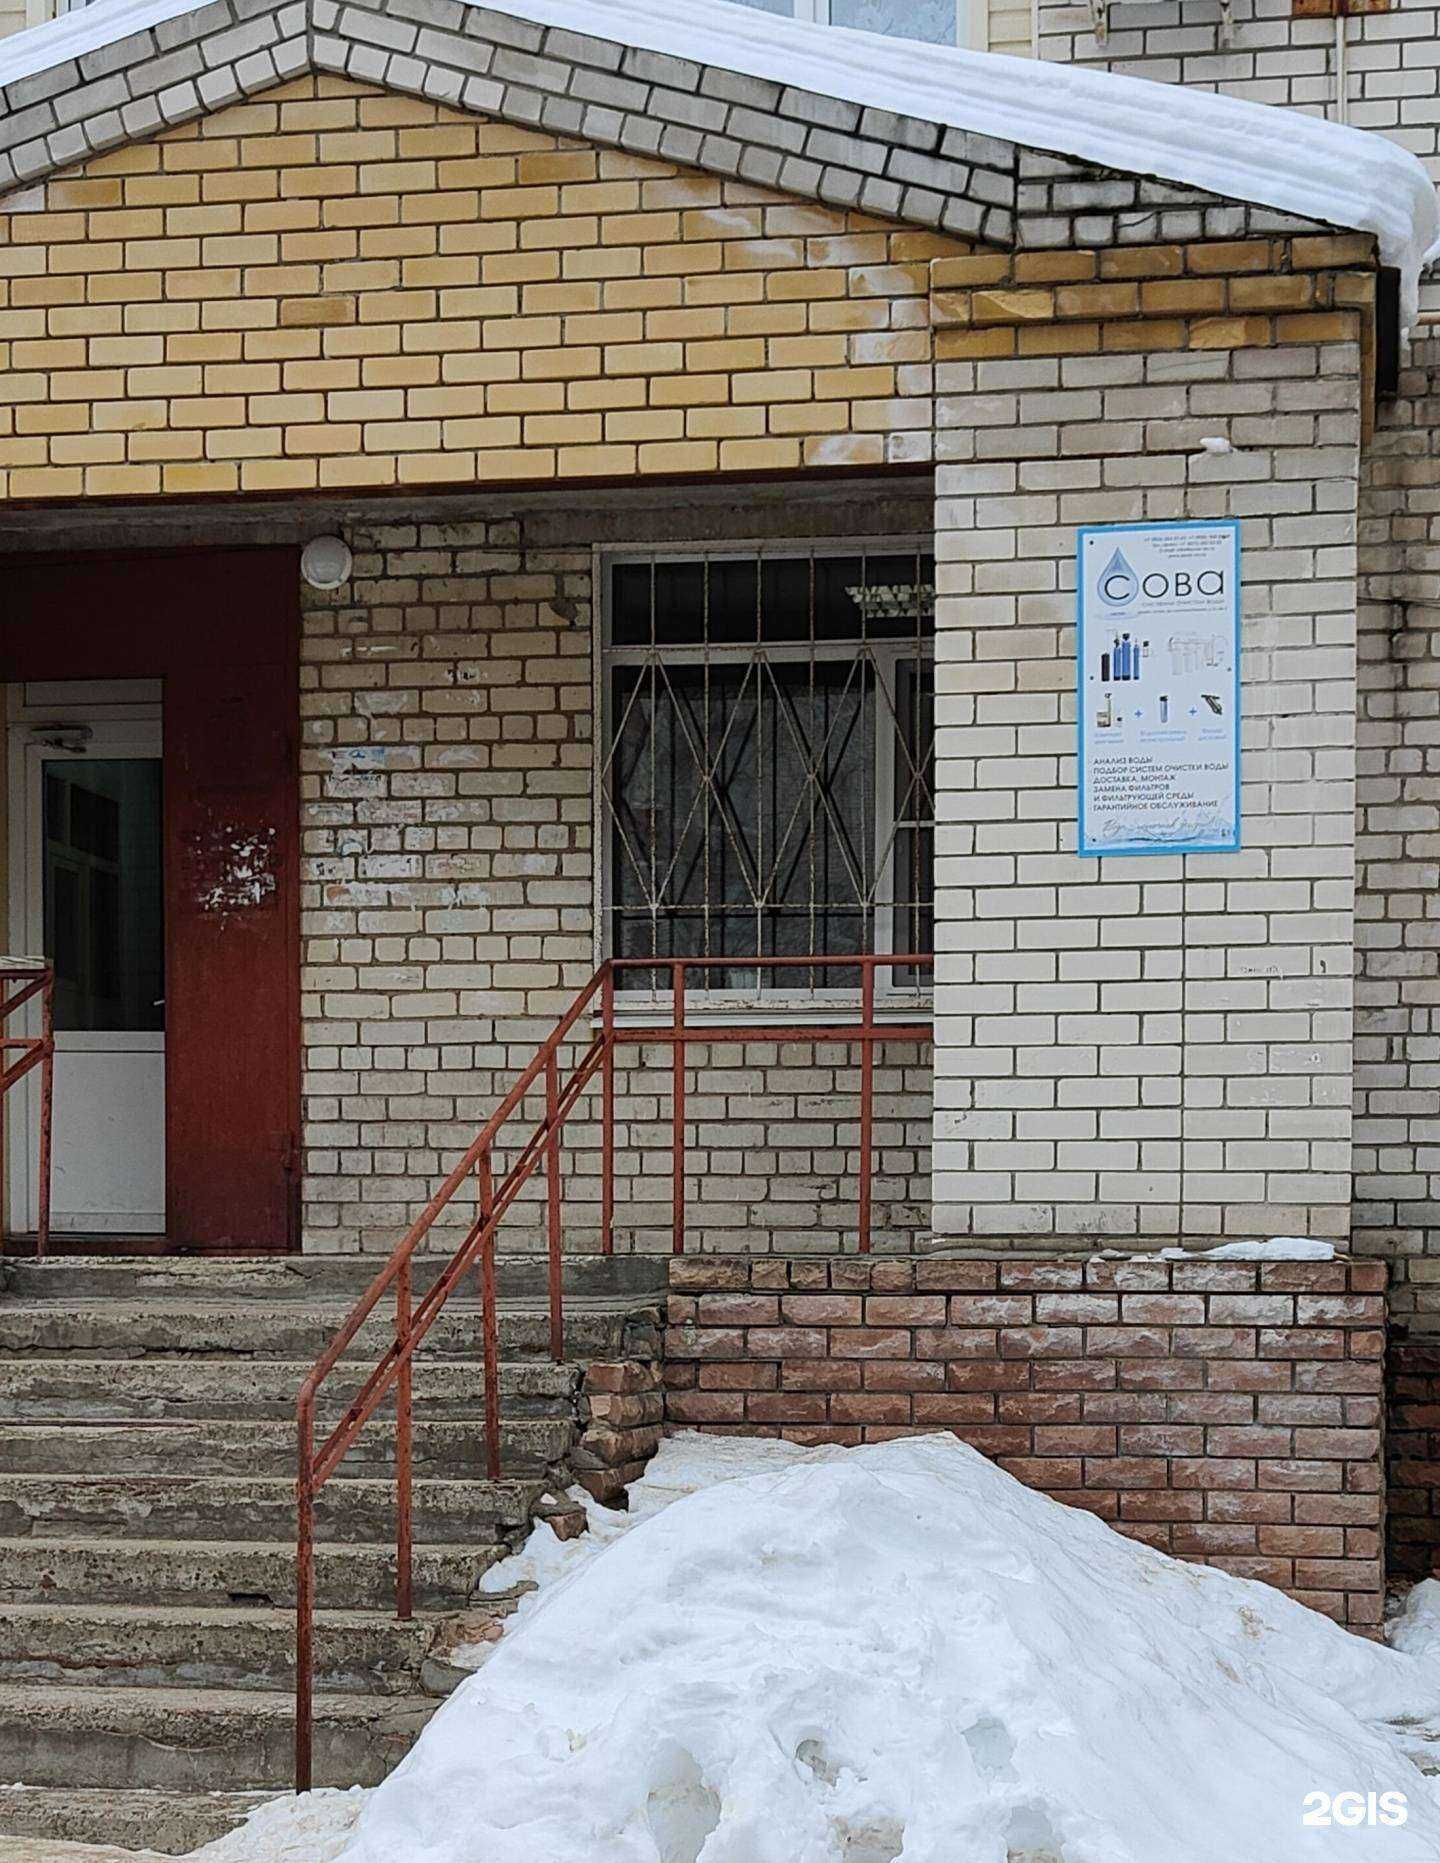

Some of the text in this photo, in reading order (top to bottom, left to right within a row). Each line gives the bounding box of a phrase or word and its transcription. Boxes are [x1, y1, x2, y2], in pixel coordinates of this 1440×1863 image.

[1093, 756, 1153, 765] АНАЛИЗ ВОДЫ
[1093, 762, 1229, 775] ПОДБОР СИСТЕМ ОЧИСТКИ ВОДЫ
[1140, 774, 1176, 782] МОНТАЖ
[1093, 783, 1170, 793] ЗАМЕНА ФИЛЬТРОВ
[1165, 792, 1194, 800] СРЕДЫ
[1093, 800, 1218, 811] ГАРАНТИЙНОЕ ОБСЛУЖИВАНИЕ
